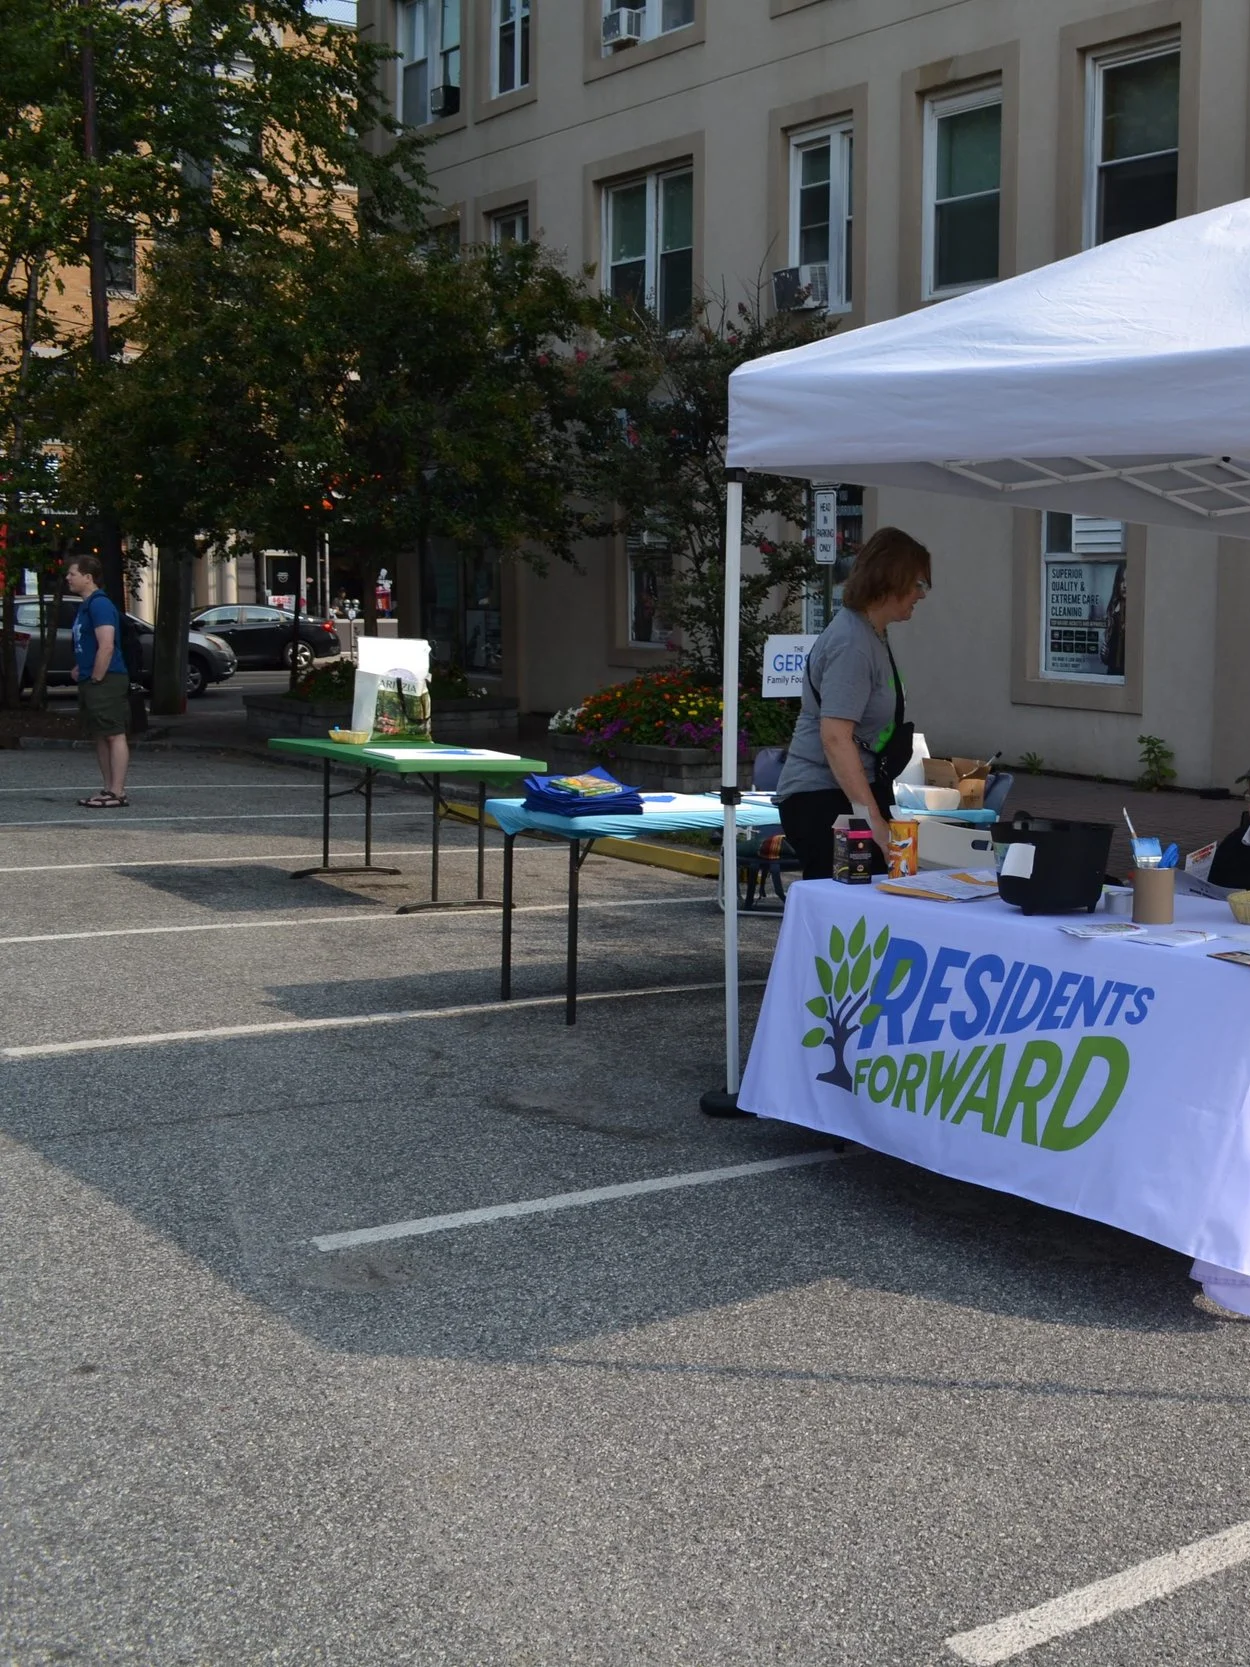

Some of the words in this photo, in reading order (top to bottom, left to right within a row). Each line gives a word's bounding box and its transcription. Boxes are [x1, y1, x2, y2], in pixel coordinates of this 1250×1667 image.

[820, 502, 831, 512] HEAD
[824, 516, 828, 524] IN
[817, 529, 834, 538] PARKING
[819, 544, 831, 552] ONLY
[1052, 568, 1082, 579] SUPERIOR
[1052, 582, 1079, 592] QUALITY
[1080, 582, 1084, 592] &
[1052, 594, 1081, 604] EXTREME
[1082, 594, 1099, 604] CARE
[1051, 607, 1082, 616] CLEANING
[767, 676, 789, 685] Family
[381, 679, 416, 693] ARIZIA
[856, 937, 1155, 1050] RESIDENTS
[853, 1035, 1131, 1152] FORWARD
